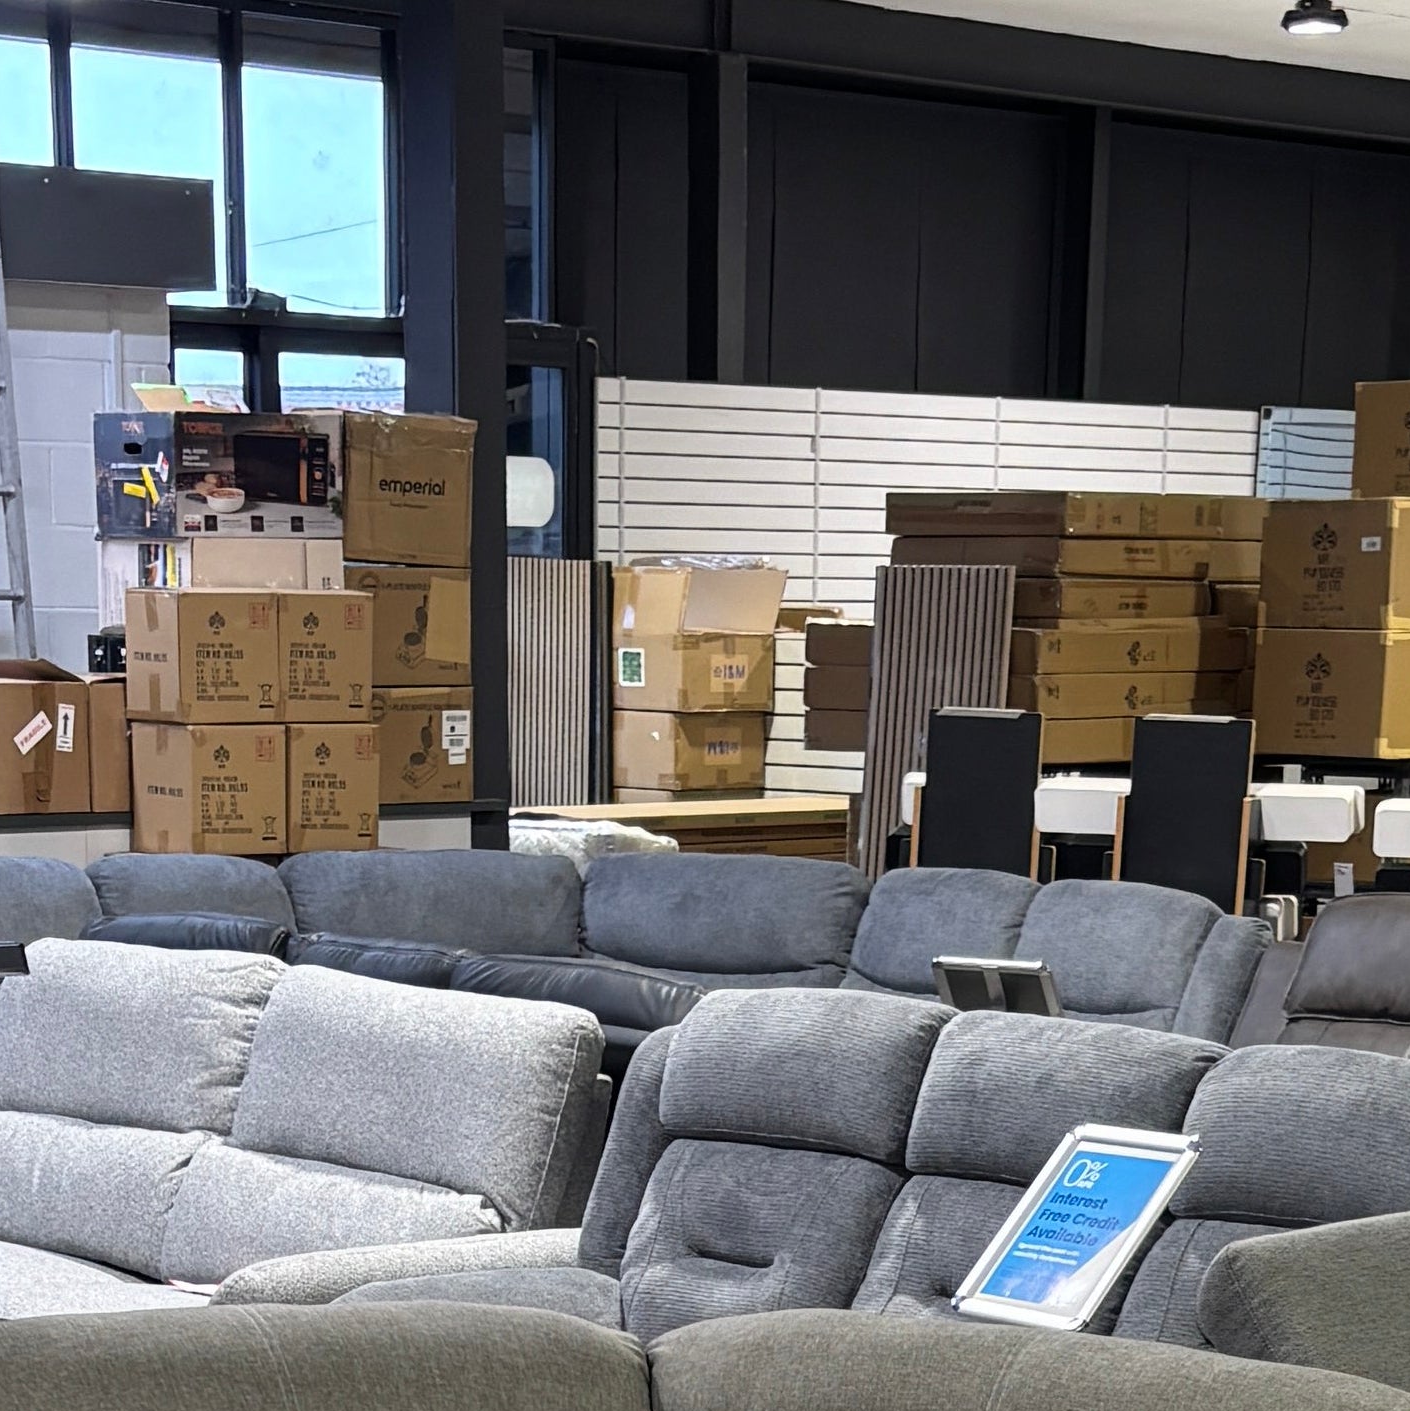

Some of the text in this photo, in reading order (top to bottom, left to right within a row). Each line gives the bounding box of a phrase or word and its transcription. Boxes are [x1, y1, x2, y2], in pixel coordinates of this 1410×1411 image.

[379, 477, 446, 497] emperial
[1063, 1158, 1109, 1188] 0%
[1048, 1191, 1108, 1211] Interest
[1038, 1208, 1120, 1231] Free Credit
[1027, 1226, 1098, 1247] Available
